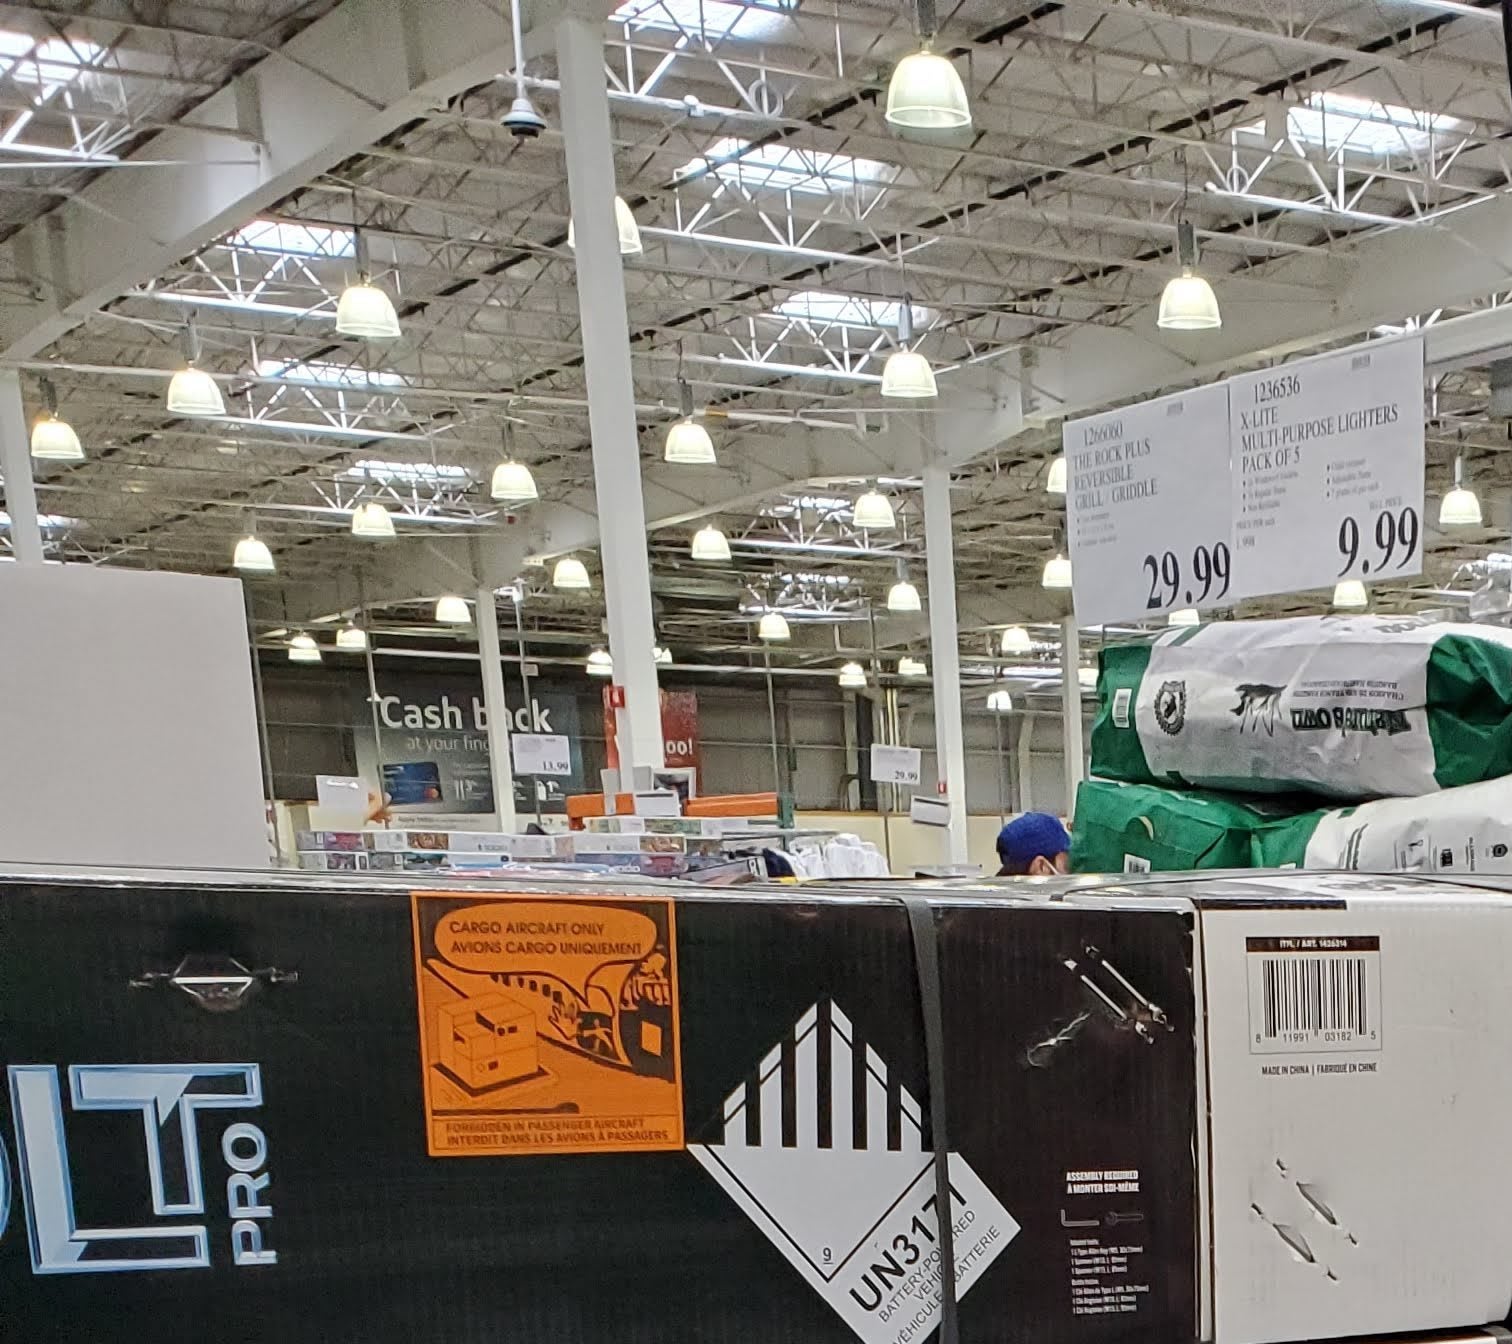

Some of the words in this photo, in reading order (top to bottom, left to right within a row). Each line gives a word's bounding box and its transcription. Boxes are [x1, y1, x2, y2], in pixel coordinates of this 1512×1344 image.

[1254, 375, 1300, 404] 1236536
[1241, 407, 1278, 430] X-LITE
[1241, 419, 1335, 452] MULTI-PURPOSE
[1338, 404, 1398, 435] LIGHTERS
[1074, 452, 1093, 471] THE
[1095, 446, 1123, 468] ROCK
[1125, 439, 1150, 459] PLUS
[1242, 452, 1272, 473] PACK
[1275, 450, 1290, 468] OF
[1293, 446, 1300, 465] 5
[1074, 465, 1134, 491] REVERSIBLE
[1075, 489, 1103, 511] GRILL
[1112, 479, 1157, 504] GRIDDLE
[1338, 507, 1418, 577] 9.99
[1143, 541, 1231, 609] 29.99
[380, 696, 462, 730] Cash
[408, 736, 423, 751] at
[425, 737, 458, 751] your
[450, 921, 500, 934] CARGO
[506, 922, 567, 934] AIRCRAFT
[572, 923, 604, 935] ONLY
[451, 942, 501, 954] AVIONS
[506, 942, 556, 954] CARGO
[560, 942, 641, 955] UNIQUEMENT
[1256, 1034, 1261, 1043] 8
[1284, 1033, 1309, 1042] 11991
[1325, 1032, 1351, 1041] 03182
[1371, 1031, 1376, 1040] 5
[1262, 1067, 1280, 1075] MADE
[1282, 1066, 1288, 1074] IN
[1290, 1066, 1309, 1074] CHINA
[1317, 1063, 1347, 1074] FABRIQUÉ
[1349, 1064, 1357, 1072] EN
[1358, 1063, 1376, 1072] CHINE
[221, 1122, 278, 1266] PRO
[823, 1246, 833, 1262] 9
